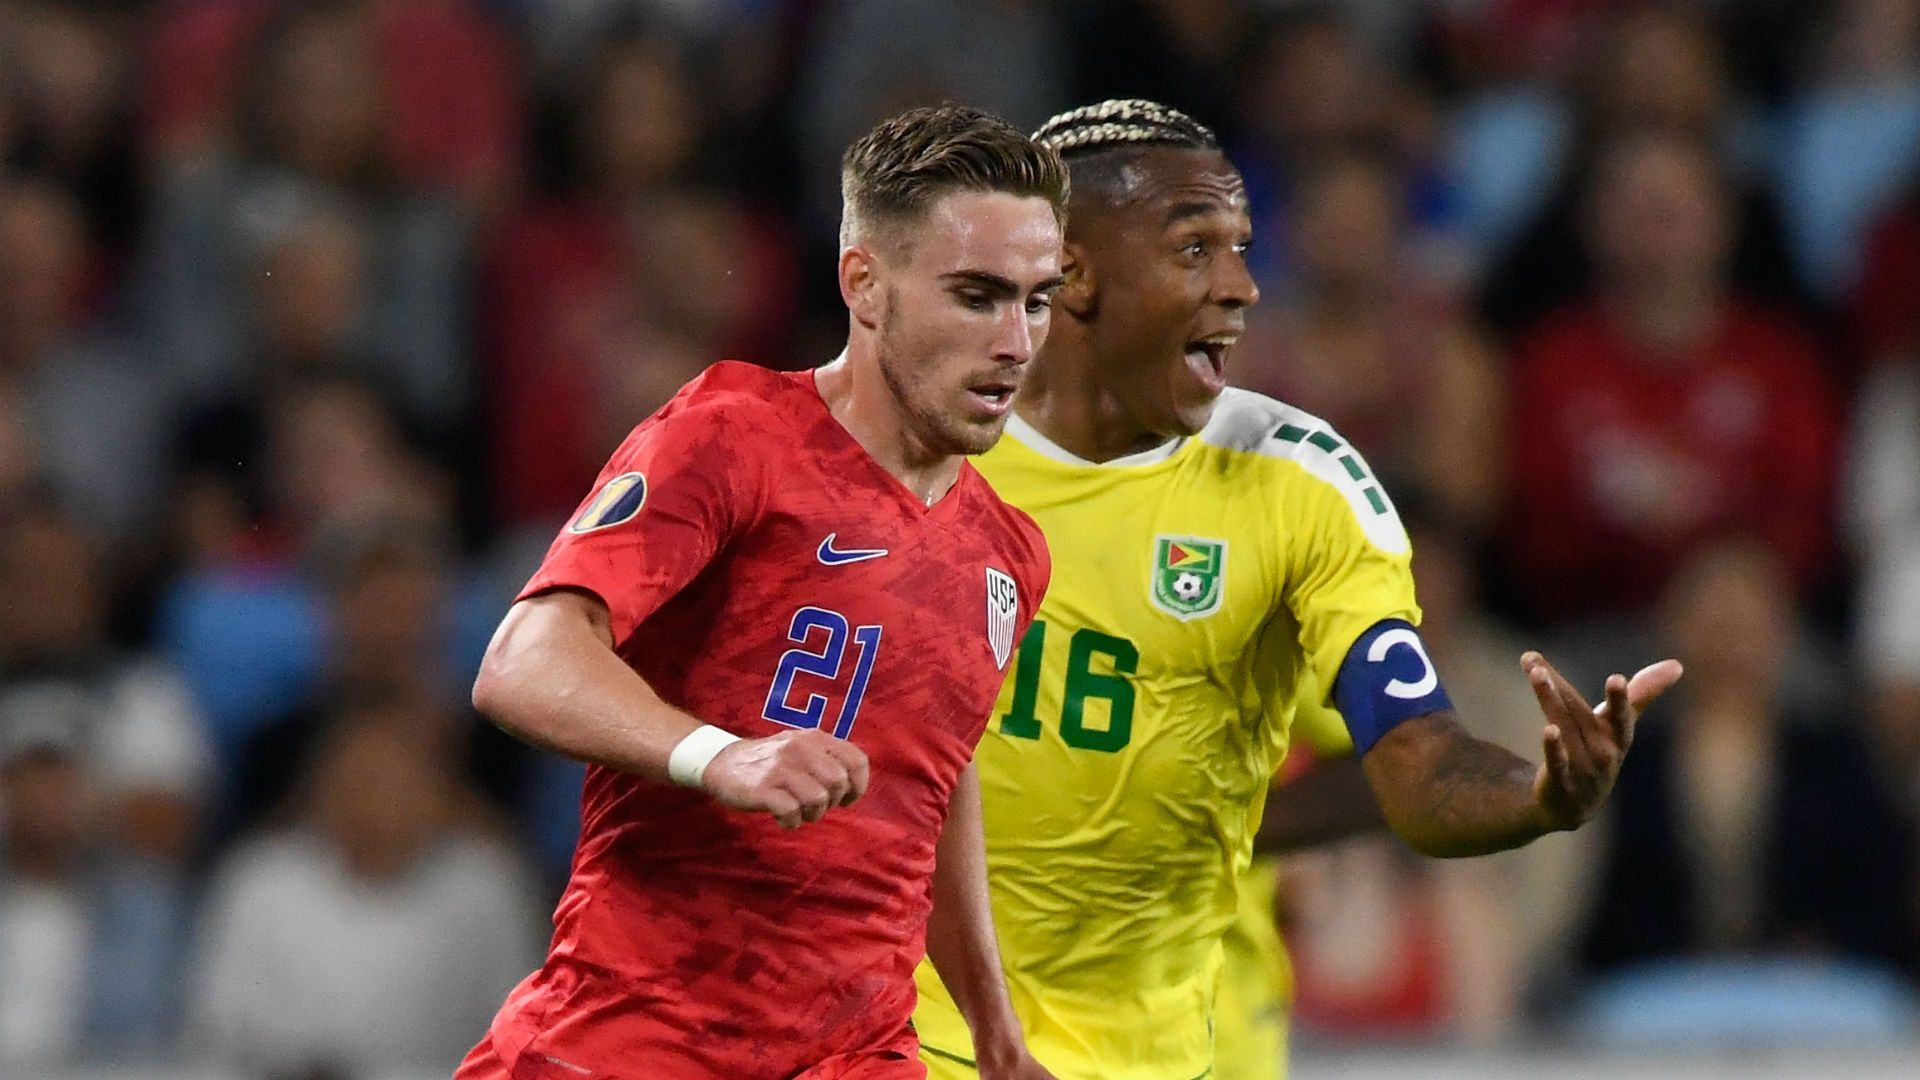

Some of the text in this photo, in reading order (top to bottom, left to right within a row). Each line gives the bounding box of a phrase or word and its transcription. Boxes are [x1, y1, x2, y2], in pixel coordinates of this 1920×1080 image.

[989, 573, 1015, 614] USA
[761, 606, 883, 740] 21
[1000, 619, 1139, 753] 16
[1367, 628, 1438, 699] C
